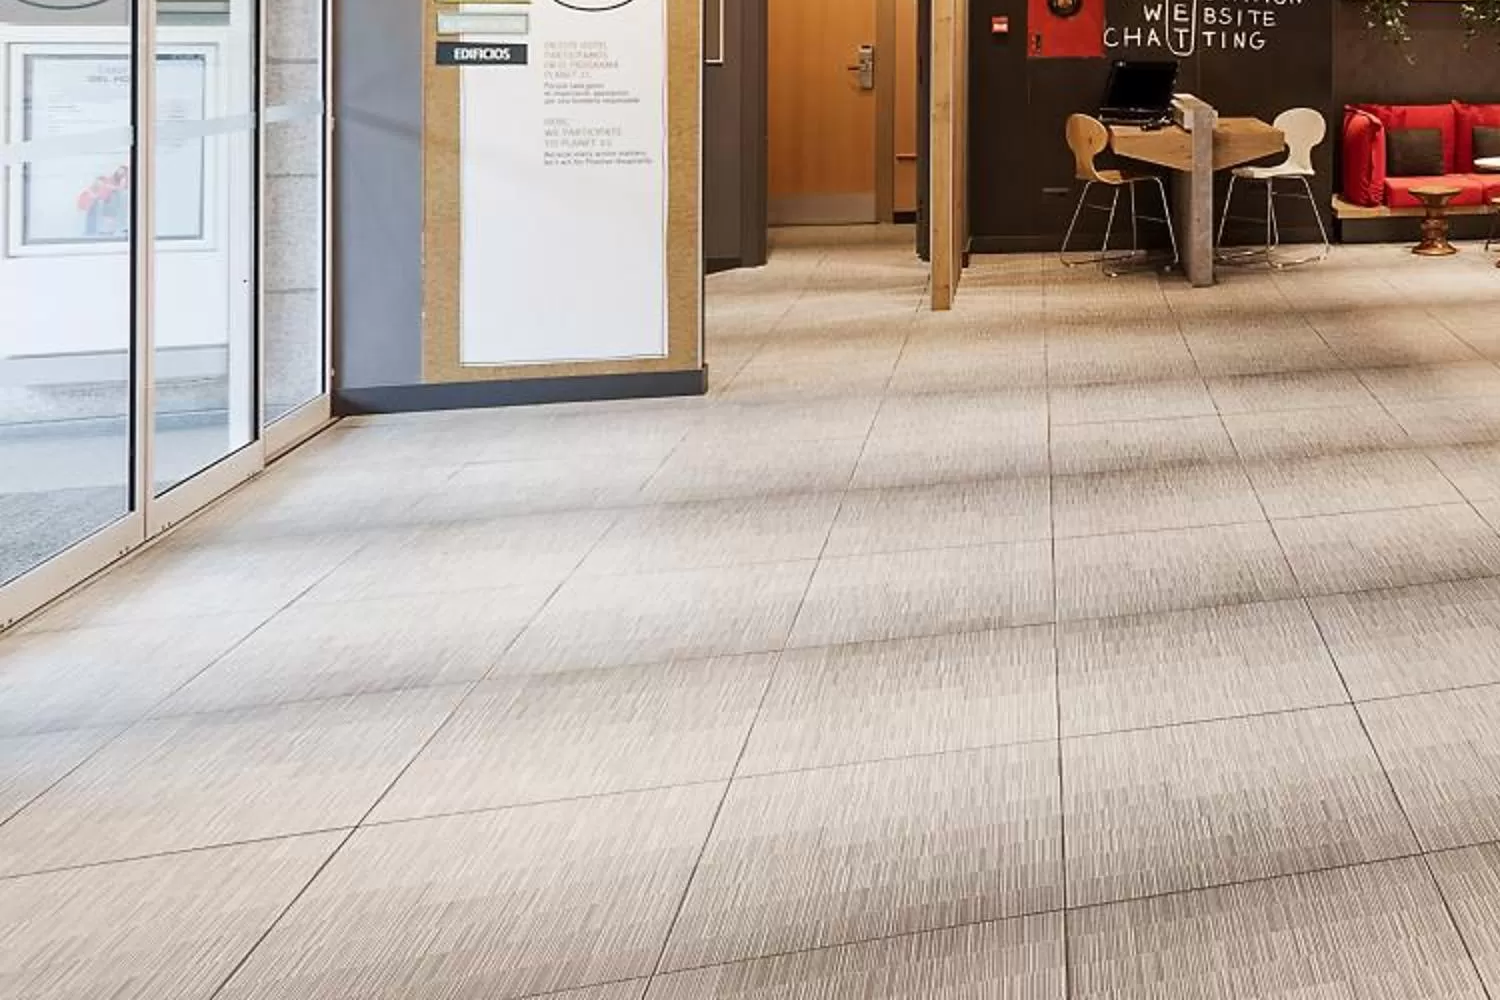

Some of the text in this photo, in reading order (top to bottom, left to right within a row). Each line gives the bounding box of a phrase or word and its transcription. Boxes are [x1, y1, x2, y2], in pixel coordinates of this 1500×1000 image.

[1144, 3, 1277, 27] WEBSITE
[1103, 27, 1266, 50] CHATTING
[453, 47, 512, 60] EDIFICIOS
